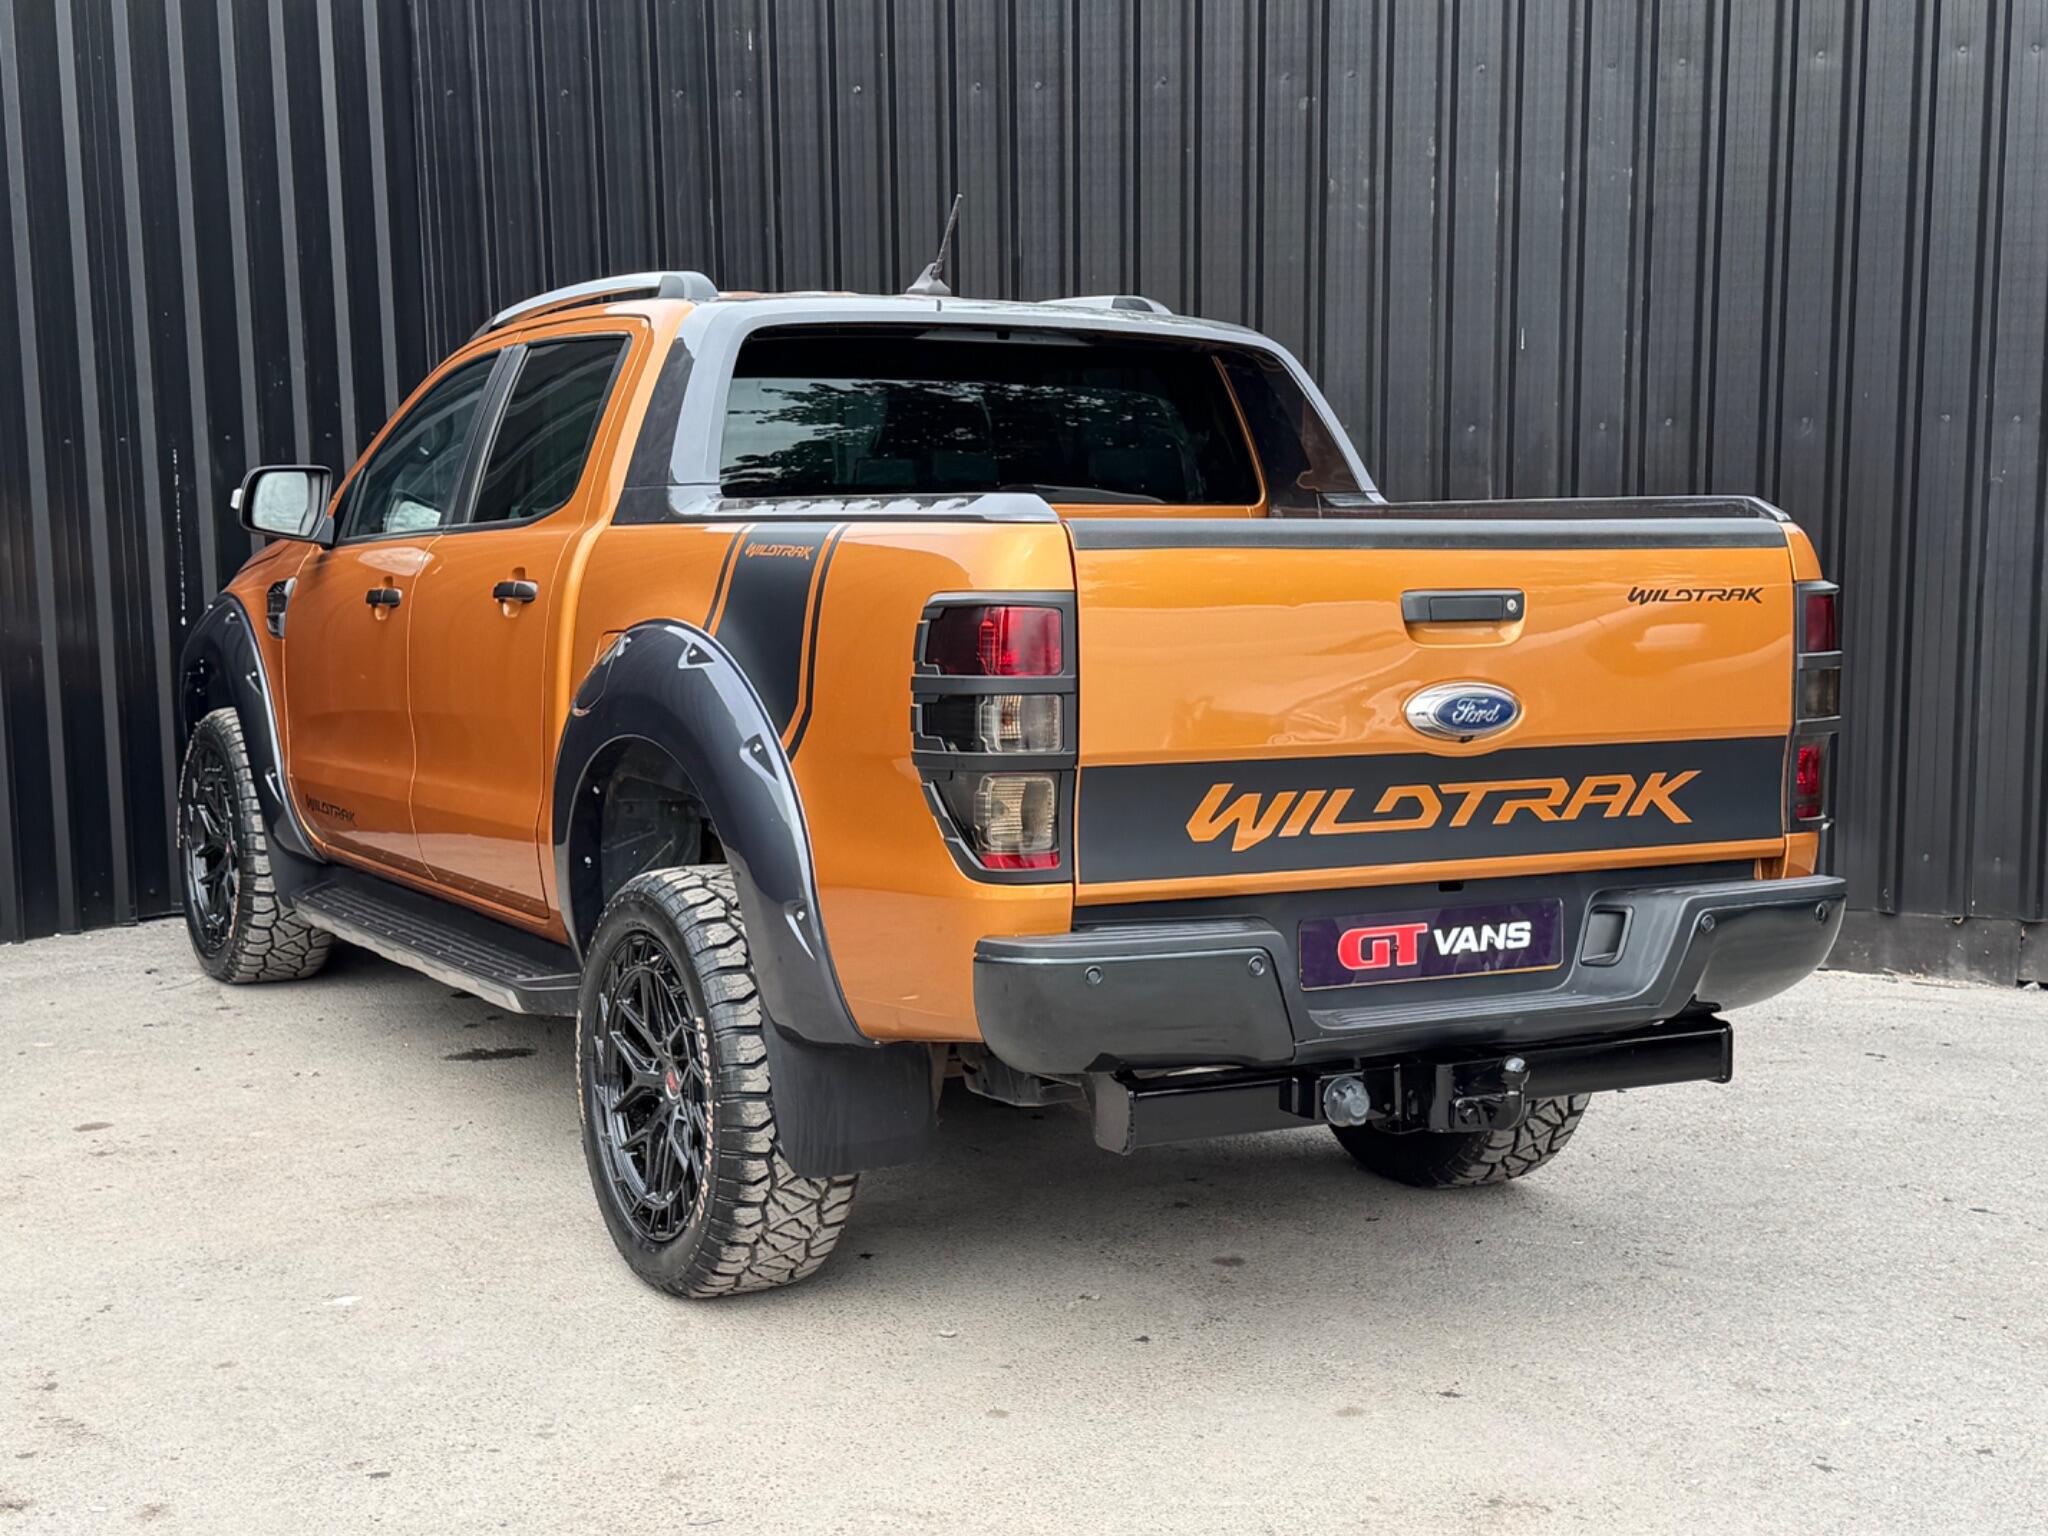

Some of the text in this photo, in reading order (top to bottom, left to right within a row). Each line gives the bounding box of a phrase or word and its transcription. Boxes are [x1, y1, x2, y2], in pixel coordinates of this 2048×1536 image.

[745, 542, 814, 560] WILDTRAK
[1627, 586, 1764, 605] WILDTRAK
[1452, 697, 1502, 724] Ford
[305, 793, 358, 828] WILDTRAK
[1186, 770, 1702, 852] WILDTRAK
[1337, 920, 1532, 971] GT VANS
